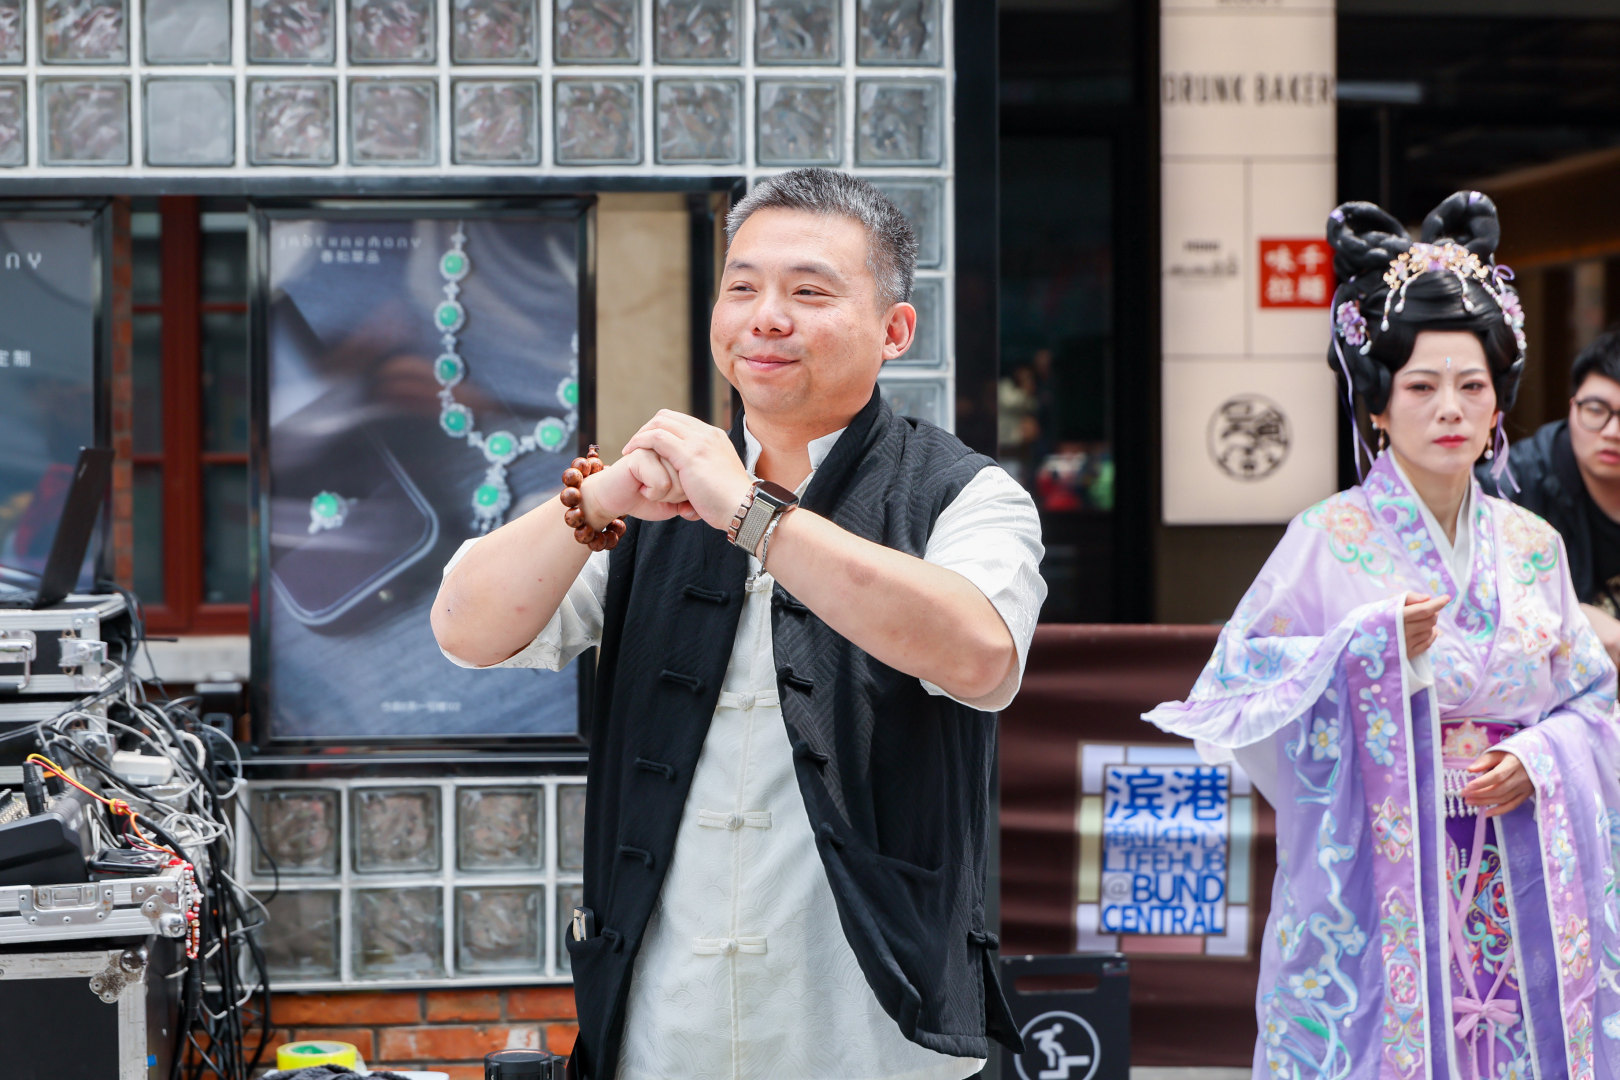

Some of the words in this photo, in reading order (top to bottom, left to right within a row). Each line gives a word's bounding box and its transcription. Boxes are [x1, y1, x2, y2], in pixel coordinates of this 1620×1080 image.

[1162, 74, 1246, 104] DRUNK
[1107, 767, 1228, 821] 滨港
[1105, 821, 1227, 851] 商业中心
[1104, 850, 1226, 873] LIFEHUB
[1102, 904, 1224, 934] CENTRAL
